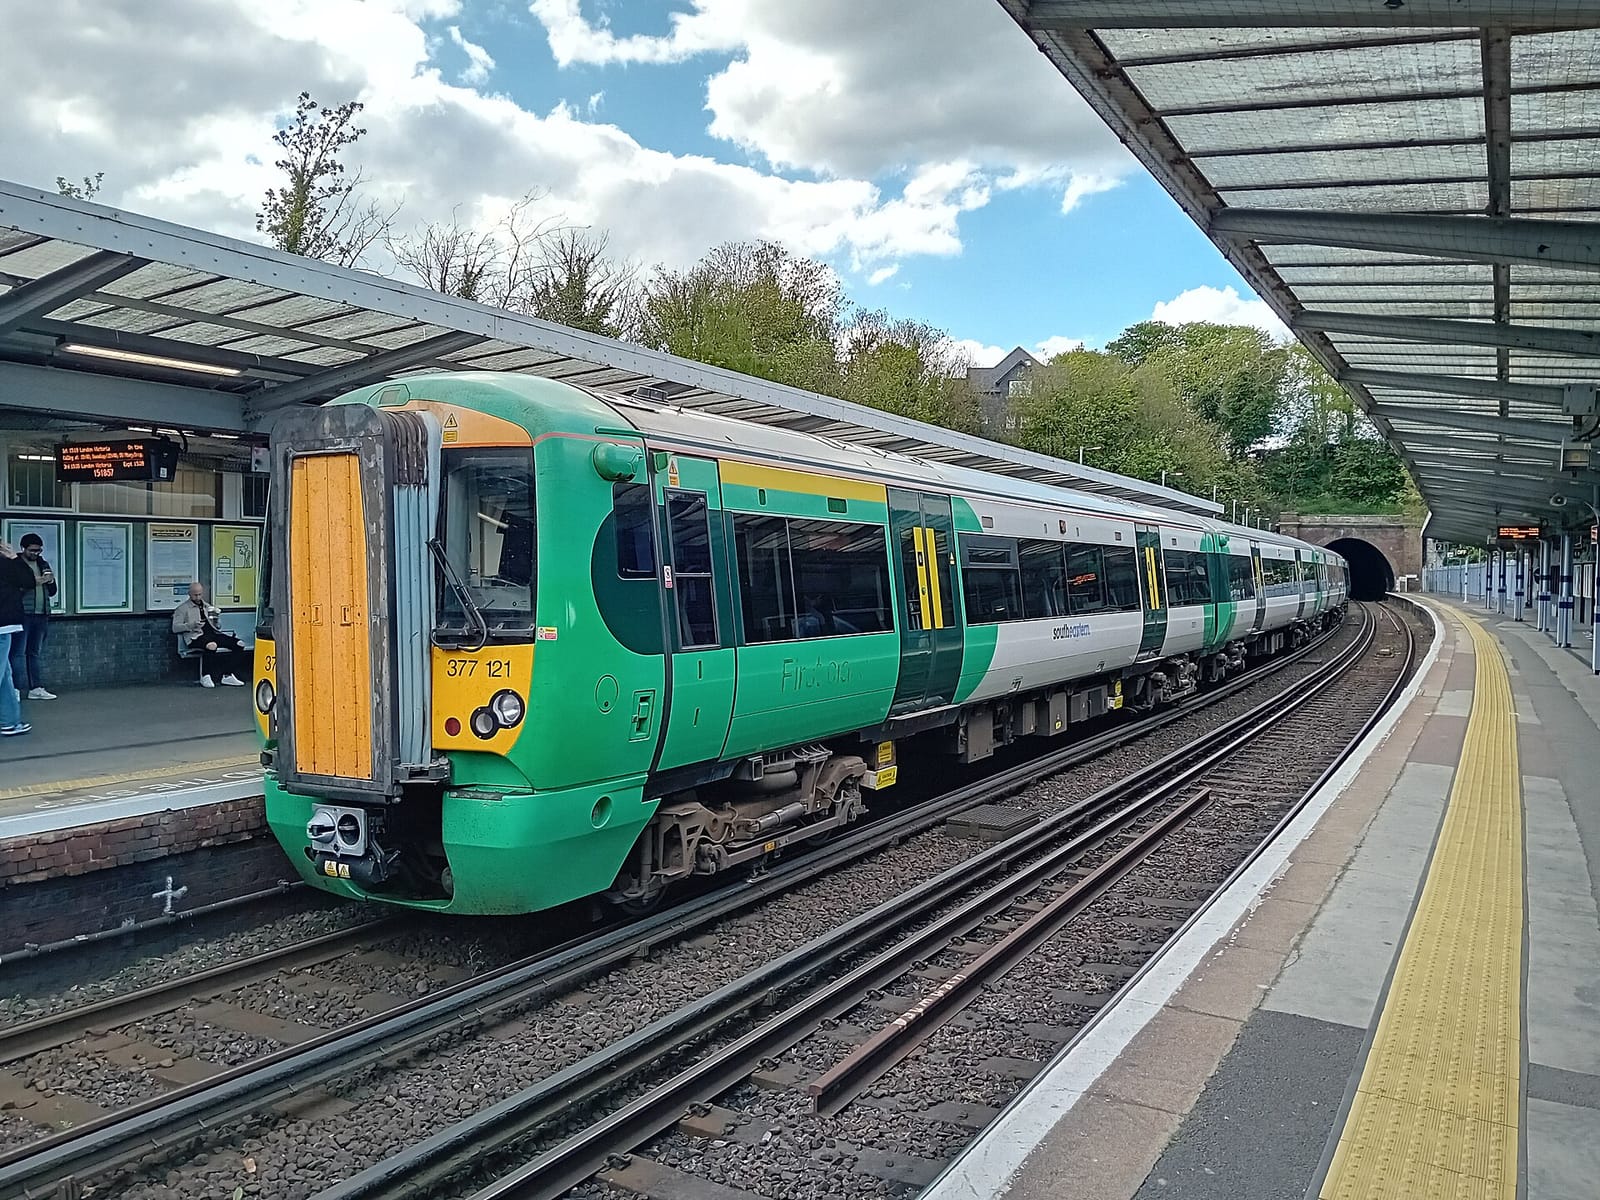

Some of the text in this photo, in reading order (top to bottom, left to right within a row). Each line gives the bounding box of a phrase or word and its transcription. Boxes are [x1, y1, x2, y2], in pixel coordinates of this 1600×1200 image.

[264, 655, 277, 672] 37
[447, 659, 511, 677] 377 121
